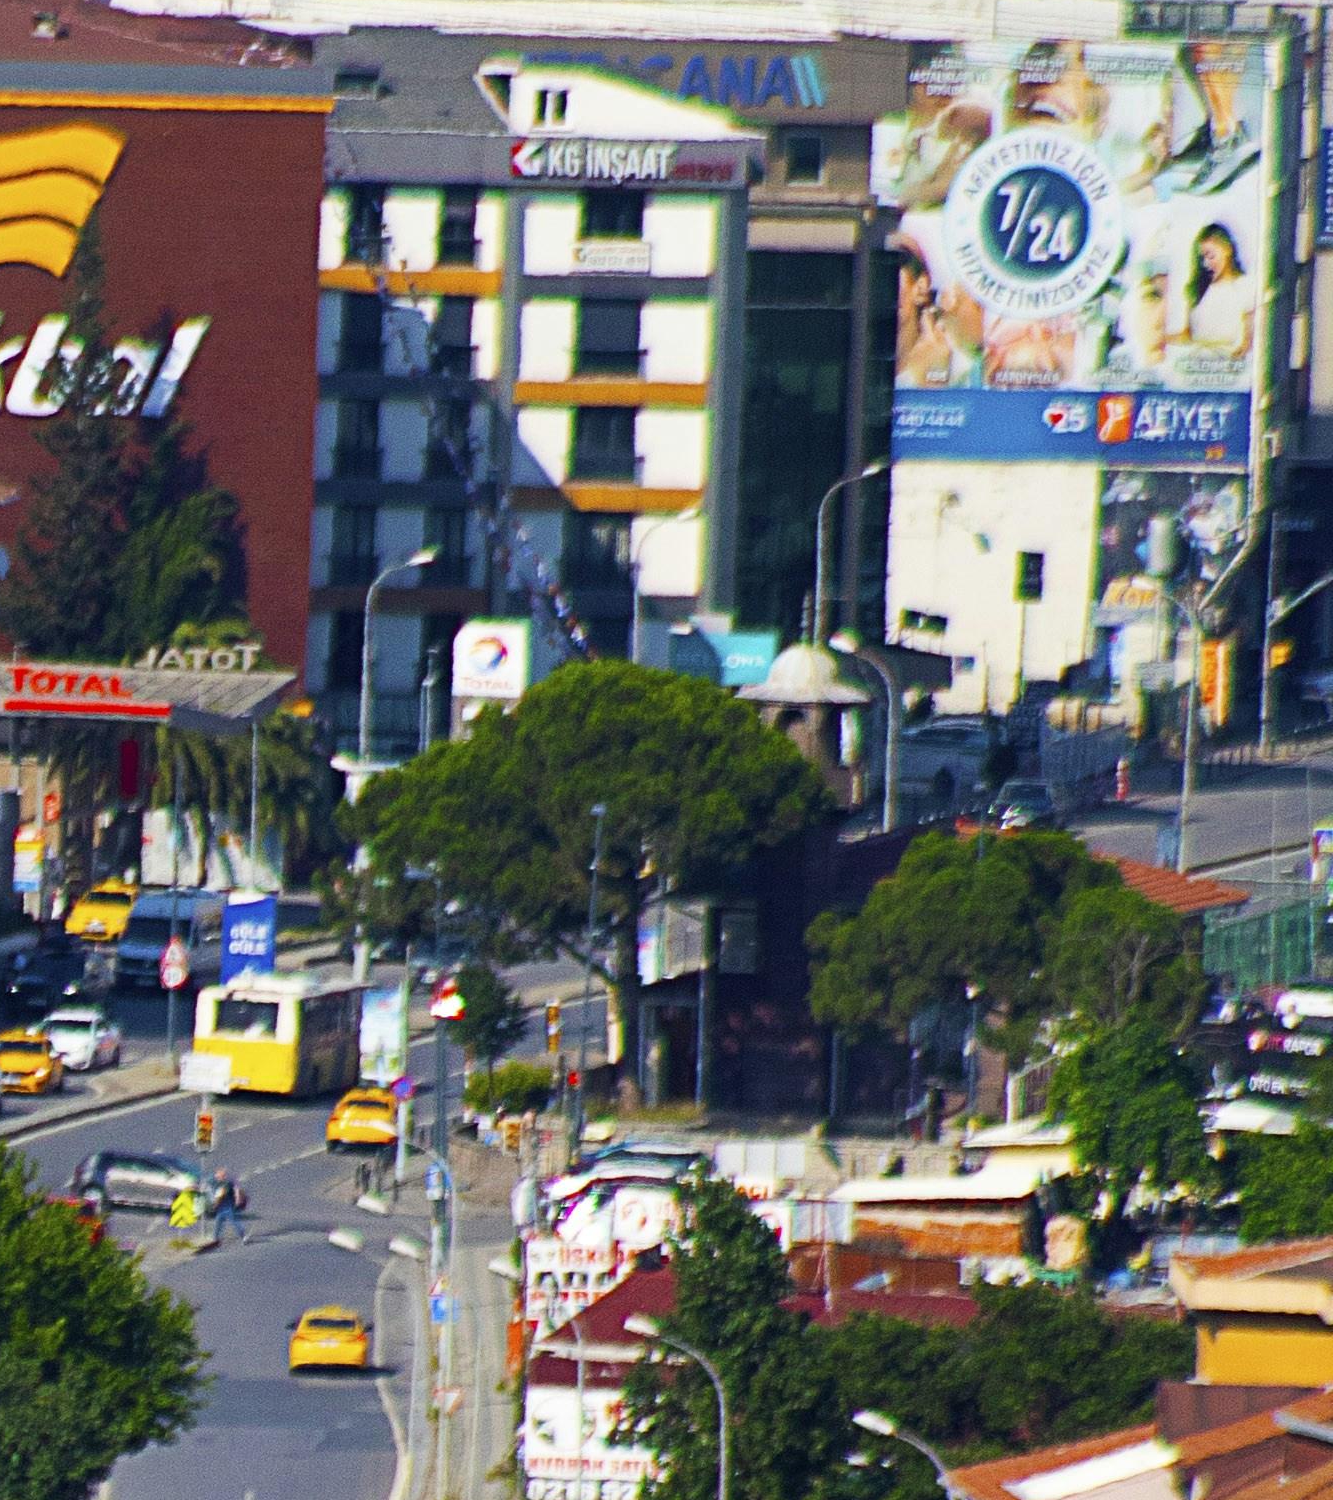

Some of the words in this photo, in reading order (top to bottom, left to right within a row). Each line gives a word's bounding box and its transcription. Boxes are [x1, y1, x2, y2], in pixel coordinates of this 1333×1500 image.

[547, 142, 583, 179] KG
[585, 143, 675, 185] İNŞAAT
[997, 176, 1079, 263] 7/24
[8, 666, 133, 698] TOTAL
[463, 675, 514, 691] TOTAL
